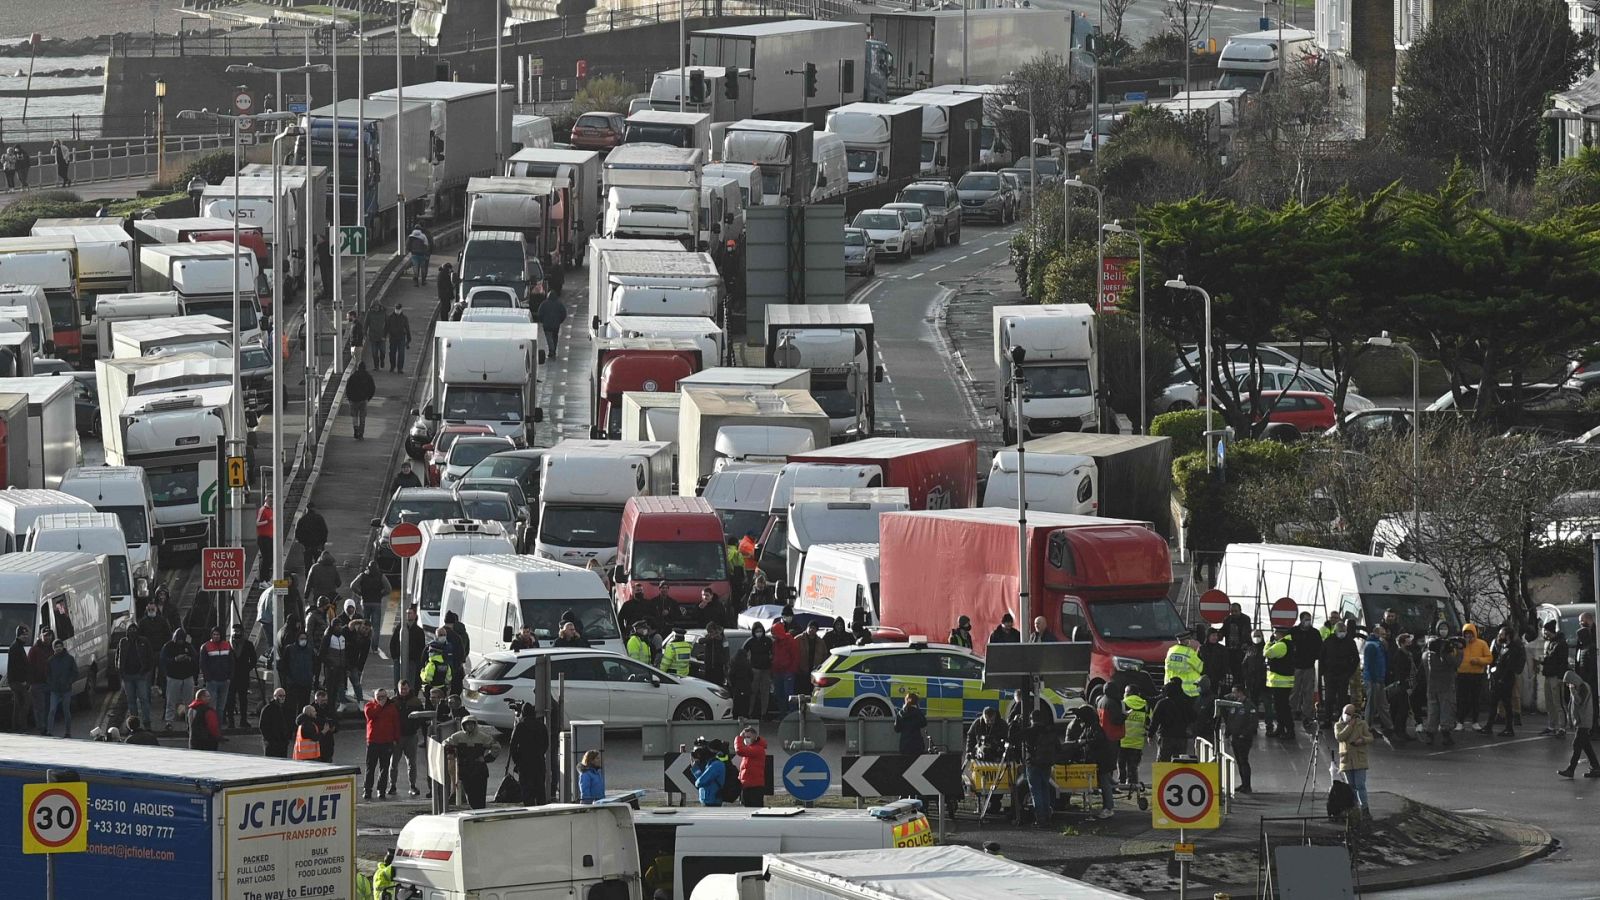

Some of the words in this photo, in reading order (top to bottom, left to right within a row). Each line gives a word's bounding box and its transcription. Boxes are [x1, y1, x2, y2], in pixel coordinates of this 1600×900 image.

[213, 551, 234, 560] NEW
[211, 560, 236, 569] ROAD
[206, 569, 241, 578] LAYOUT
[207, 578, 239, 587] AHEAD
[1166, 784, 1206, 807] 30
[133, 802, 174, 818] ARQUES
[238, 801, 265, 830] JC
[270, 793, 341, 827] FIOLET
[36, 805, 75, 830] 30
[94, 820, 112, 833] +33
[114, 821, 132, 835] 321
[135, 823, 154, 837] 987
[156, 826, 175, 839] 777
[281, 826, 337, 841] TRANSPORTS
[897, 831, 933, 849] POLICE
[311, 847, 329, 856] BULK
[243, 854, 269, 864] PACKED
[295, 859, 313, 868] FOOD
[313, 856, 345, 867] POWDERS
[254, 864, 275, 873] LOADS
[298, 870, 316, 878] FOOD
[317, 866, 342, 877] LIQUIDS
[236, 877, 253, 886] PART
[254, 874, 276, 883] LOADS
[243, 892, 262, 900] The
[264, 890, 284, 900] way
[287, 888, 297, 898] to
[300, 884, 335, 897] Europe
